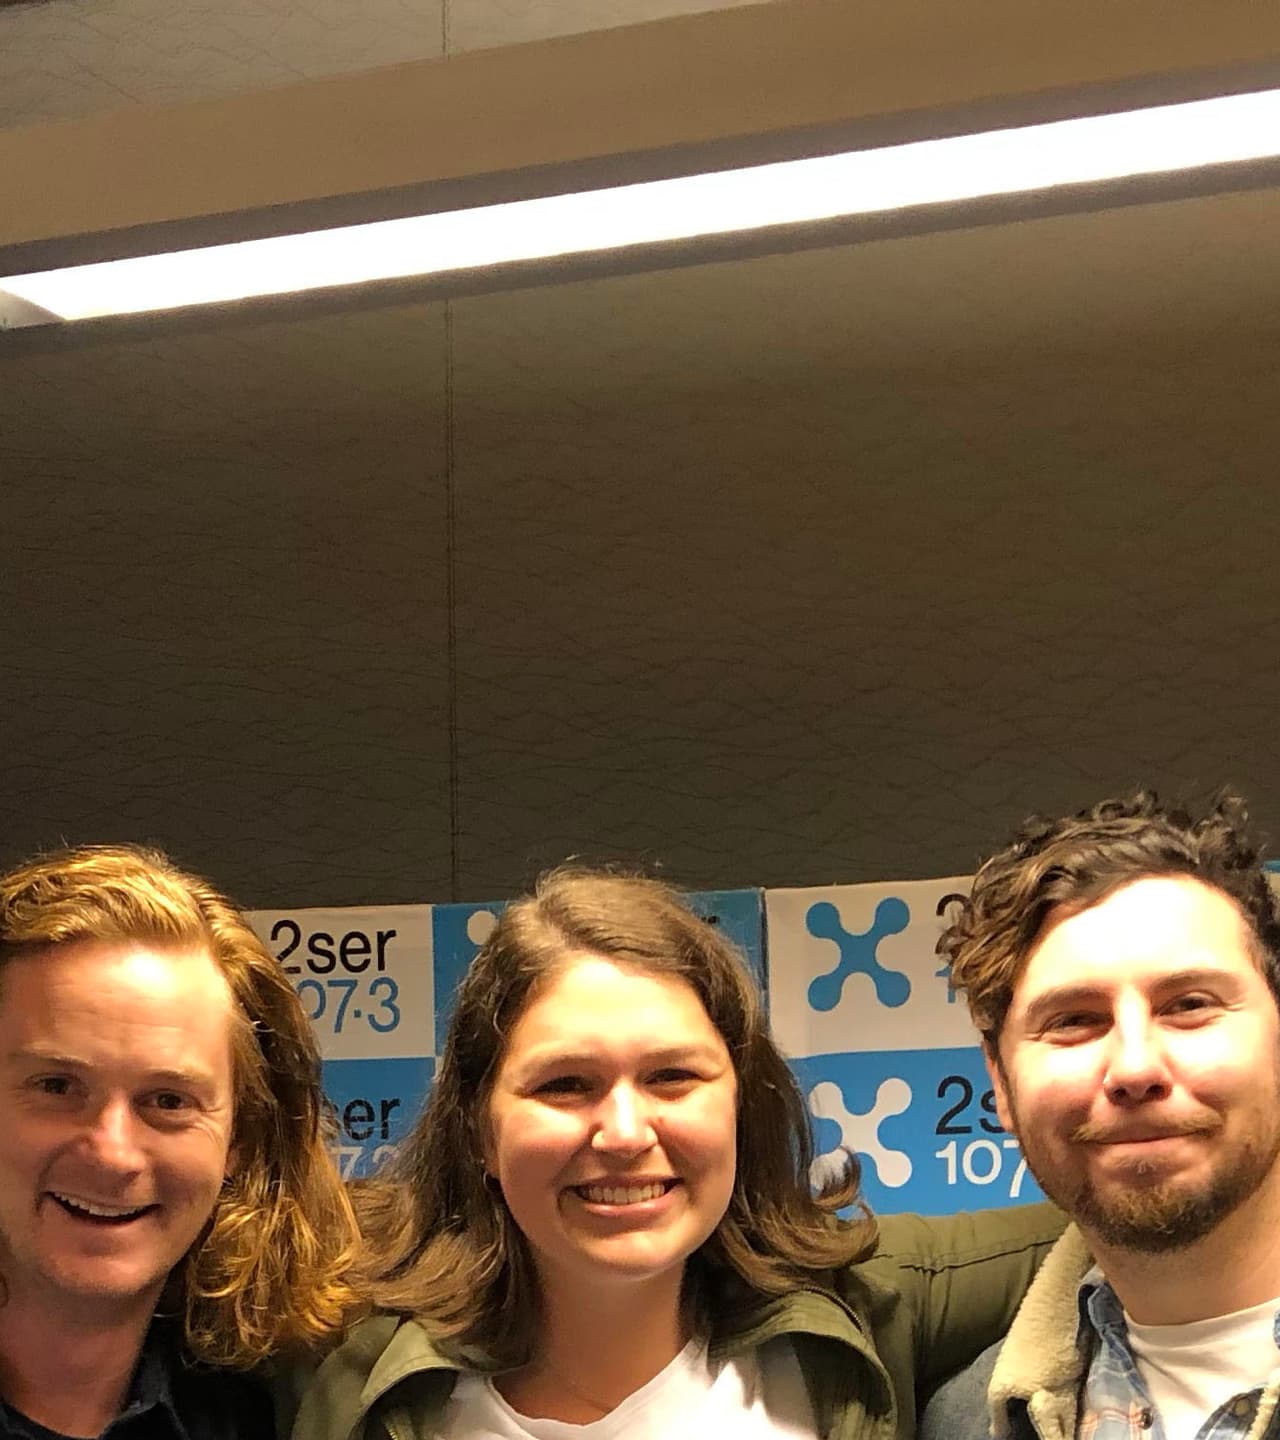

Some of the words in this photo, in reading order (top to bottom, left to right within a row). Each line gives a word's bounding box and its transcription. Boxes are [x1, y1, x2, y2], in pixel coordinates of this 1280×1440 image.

[270, 919, 396, 974] 2ser
[296, 976, 400, 1033] 07.3
[332, 1097, 400, 1140] er
[935, 1075, 1006, 1135] 2s
[935, 1139, 1028, 1199] 107
